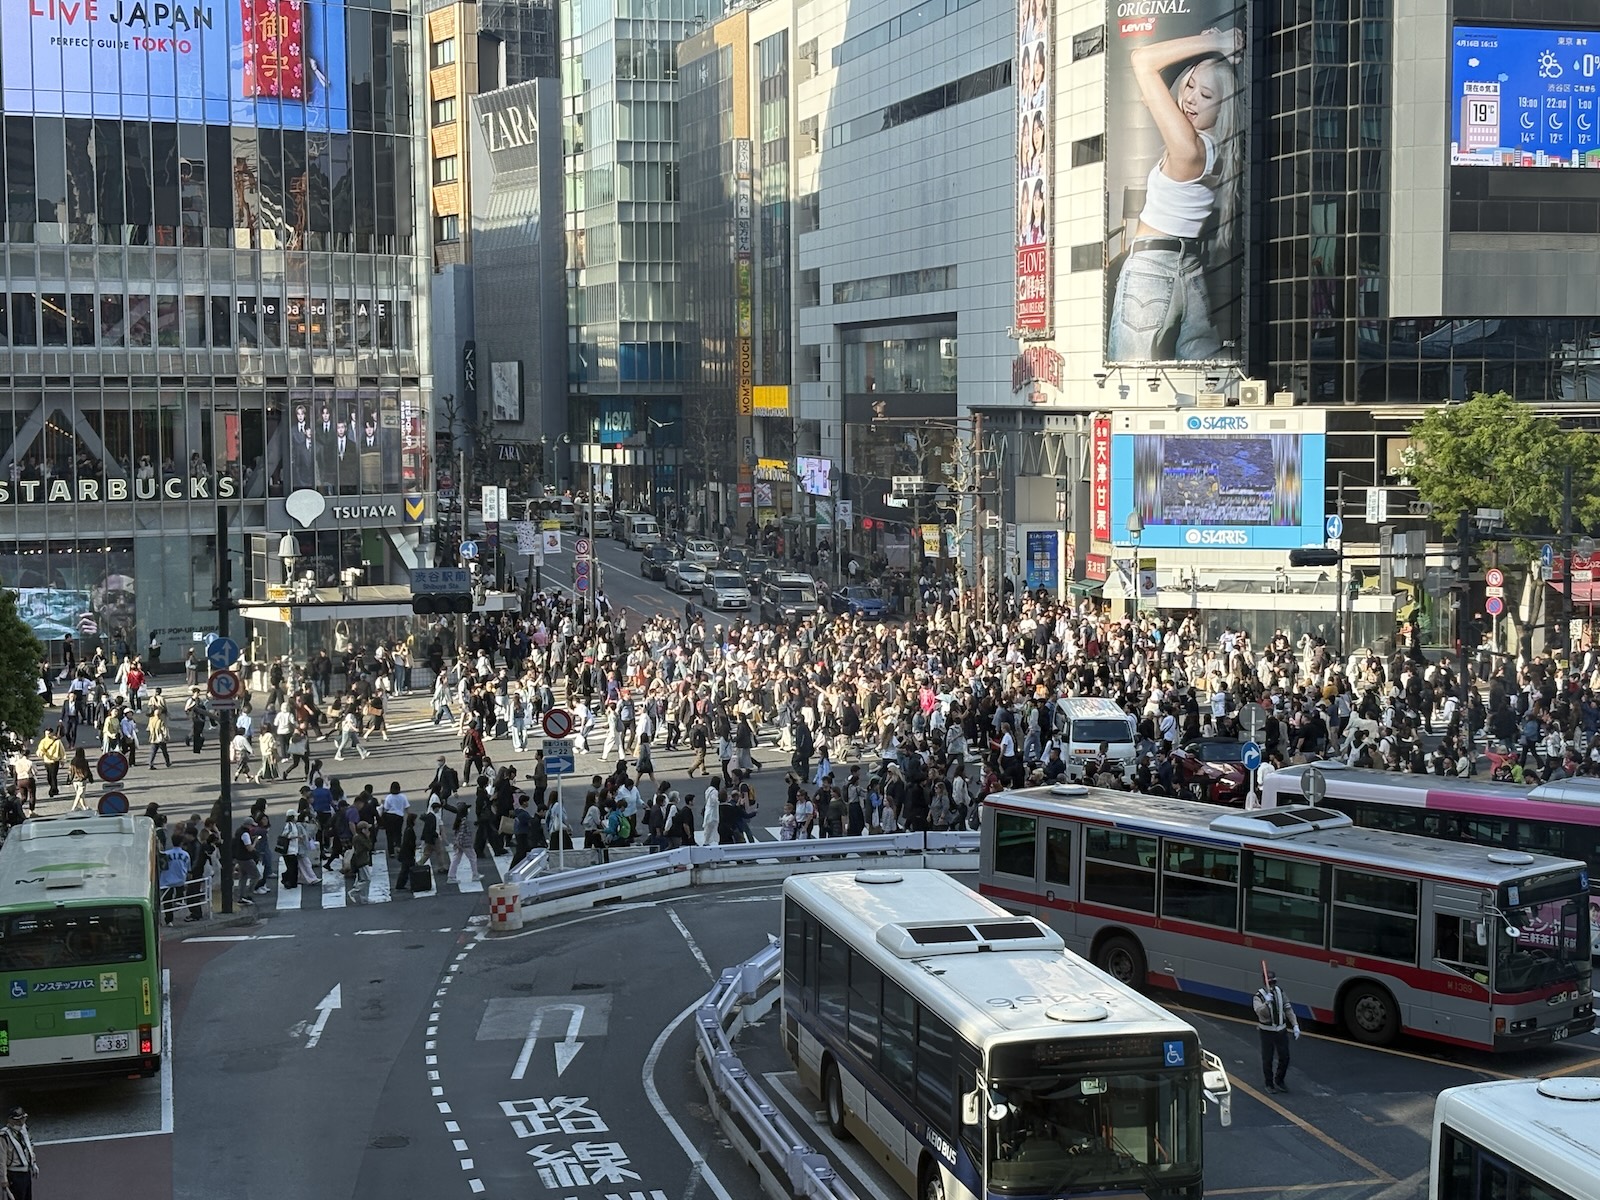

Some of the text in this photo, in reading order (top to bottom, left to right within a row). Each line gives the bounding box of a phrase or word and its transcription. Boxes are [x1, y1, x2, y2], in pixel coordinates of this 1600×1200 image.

[29, 0, 212, 32] LIVE JAPAN
[1117, 1, 1191, 17] ORIGINAL.
[50, 37, 192, 54] PERFECT GUIDE TOKYO
[1466, 84, 1498, 93] 現在の気温
[1519, 96, 1538, 108] 19:00
[1546, 97, 1567, 109] 22:00
[1578, 98, 1592, 109] 1:00
[481, 104, 537, 152] ZARA
[742, 338, 750, 376] TOUCH
[465, 349, 475, 391] ZARA
[742, 379, 750, 414] MOM'S
[499, 444, 520, 461] ZARA
[0, 477, 234, 502] STARBUCKS
[1096, 441, 1107, 530] 天津甘栗
[333, 505, 397, 519] TSUTAYA
[415, 571, 466, 582] 渋谷駅前
[33, 979, 95, 992] ノンステップバス
[498, 1096, 668, 1200] 路線
[941, 1141, 957, 1165] BUS
